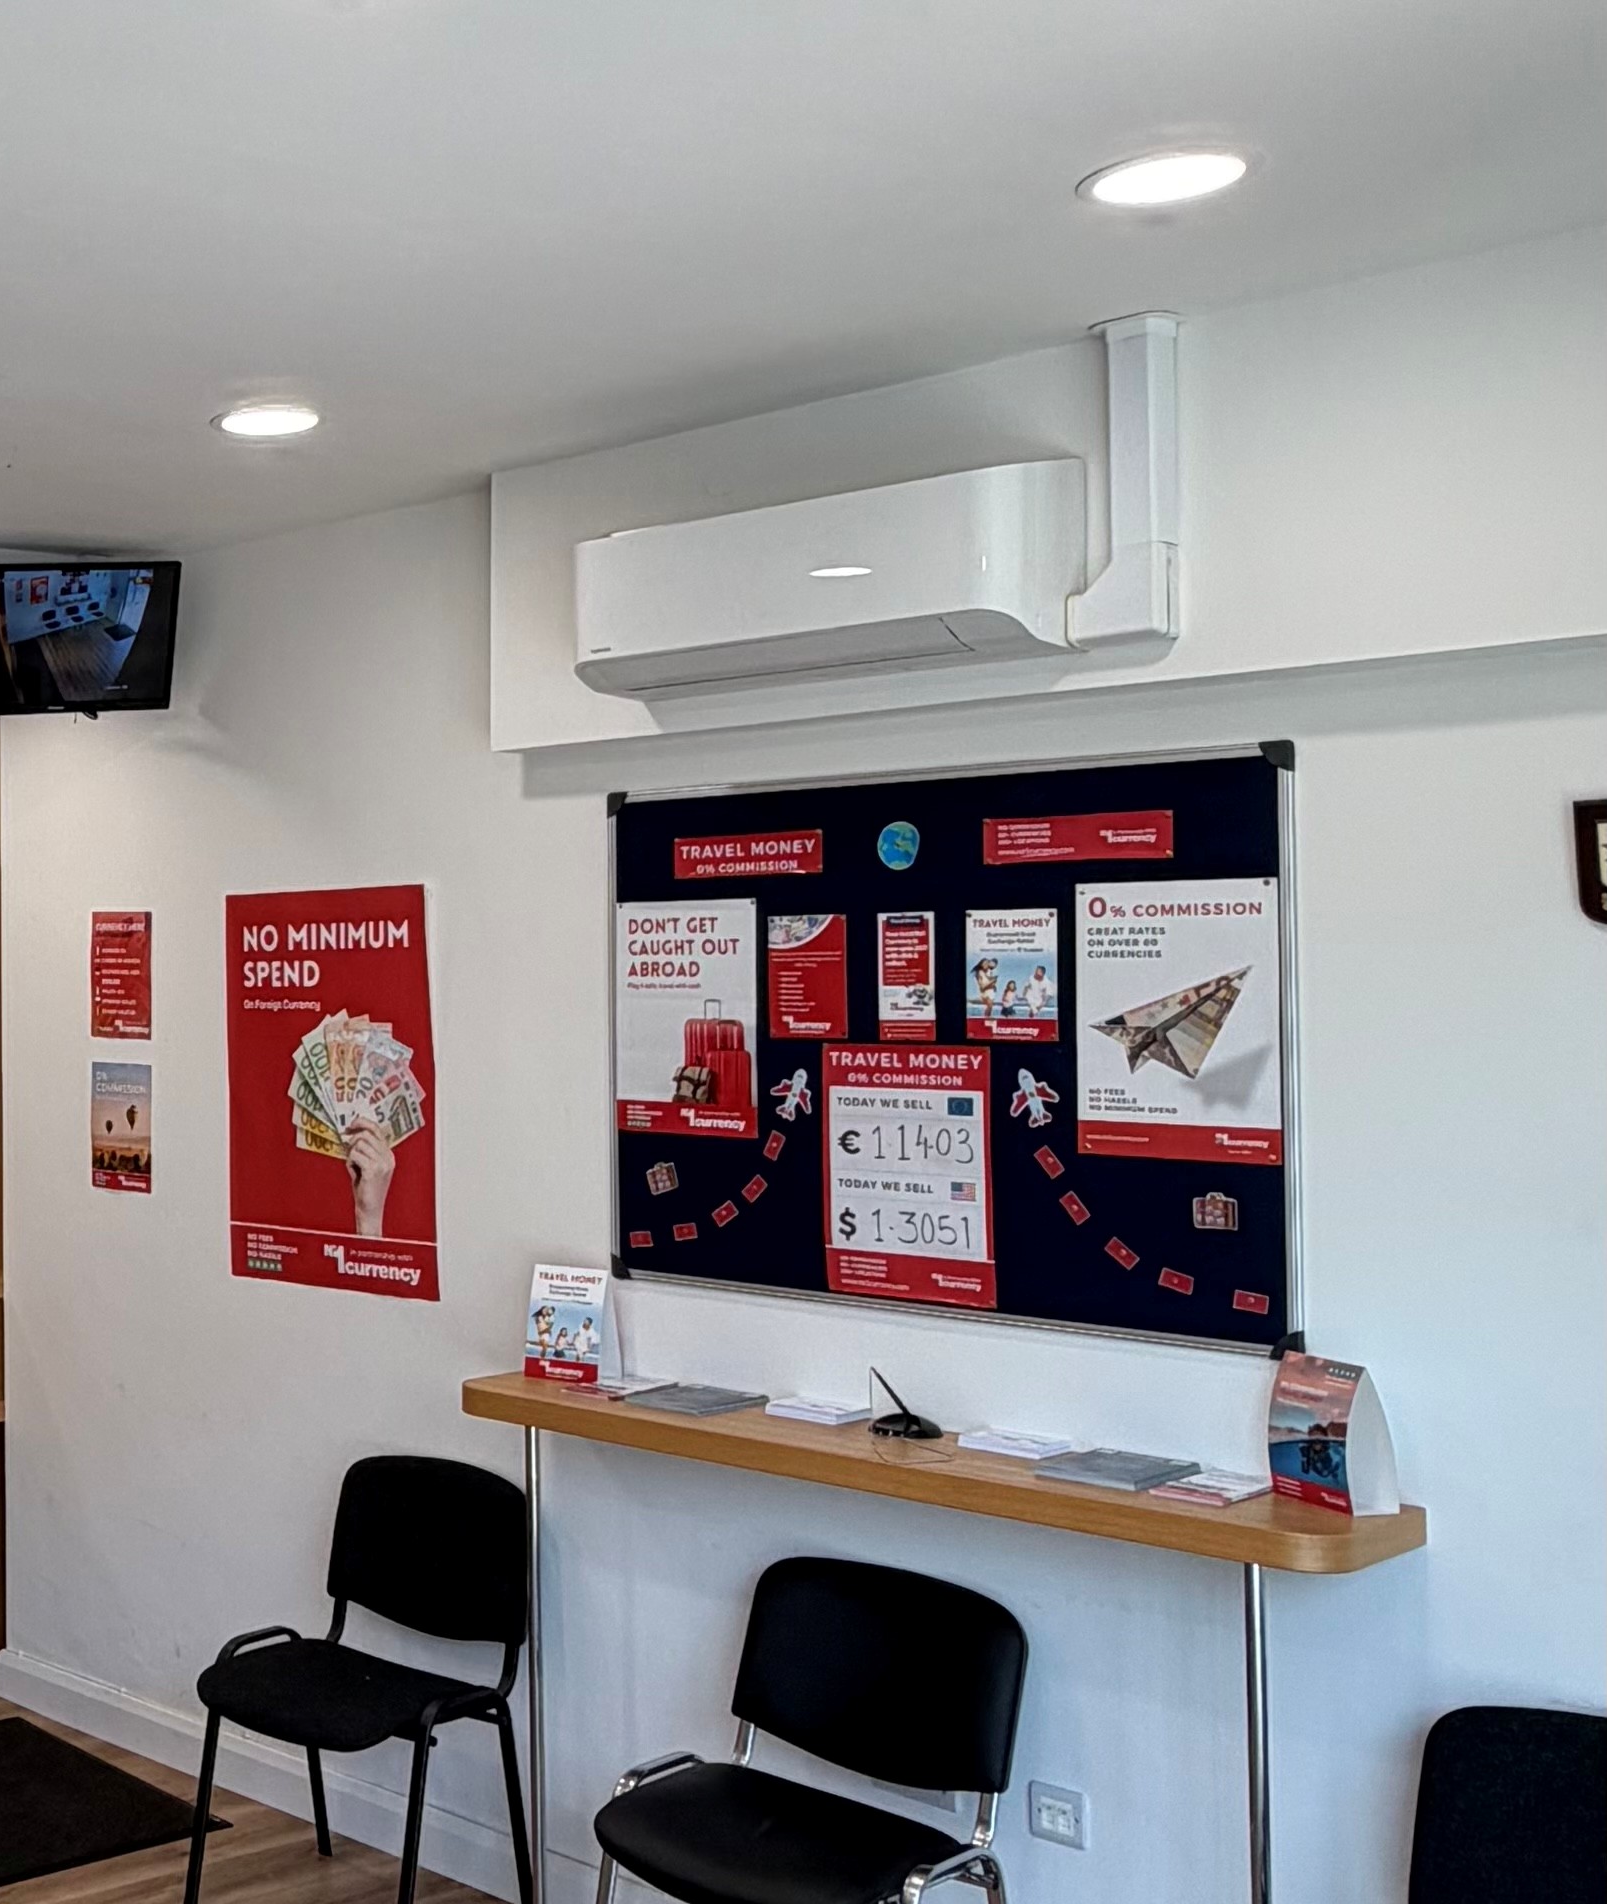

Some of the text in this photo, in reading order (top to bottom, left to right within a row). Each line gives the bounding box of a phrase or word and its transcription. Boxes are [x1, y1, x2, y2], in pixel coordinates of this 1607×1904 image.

[680, 839, 815, 859] TRAVEL MONEY
[696, 860, 798, 874] 0% COMMISSION
[1132, 902, 1262, 918] COMMISSION
[628, 917, 718, 935] DON'T GET
[972, 918, 1051, 928] TRAVEL MONEY
[243, 919, 409, 952] NO MINIMUM
[1087, 927, 1166, 936] GREAT RATES
[628, 938, 740, 956] CAUGHT OUT
[1087, 938, 1104, 947] ON
[1108, 938, 1139, 947] OVER
[1087, 950, 1162, 958] CURRENCIES
[243, 960, 320, 988] SPEND
[627, 961, 700, 977] ABROAD
[255, 999, 282, 1012] Foreign
[283, 999, 321, 1012] Currency
[829, 1051, 983, 1070] TRAVEL MONEY
[848, 1072, 962, 1086] 0% COMMISSION
[96, 1083, 146, 1094] COMMISSION
[836, 1096, 933, 1110] TODAY WE SELL
[694, 1118, 746, 1132] currency
[837, 1129, 861, 1155] €
[837, 1178, 933, 1194] TODAY WE SELL
[838, 1207, 857, 1241] $
[345, 1261, 421, 1286] currency
[539, 1271, 602, 1285] TRAVEL MONEY
